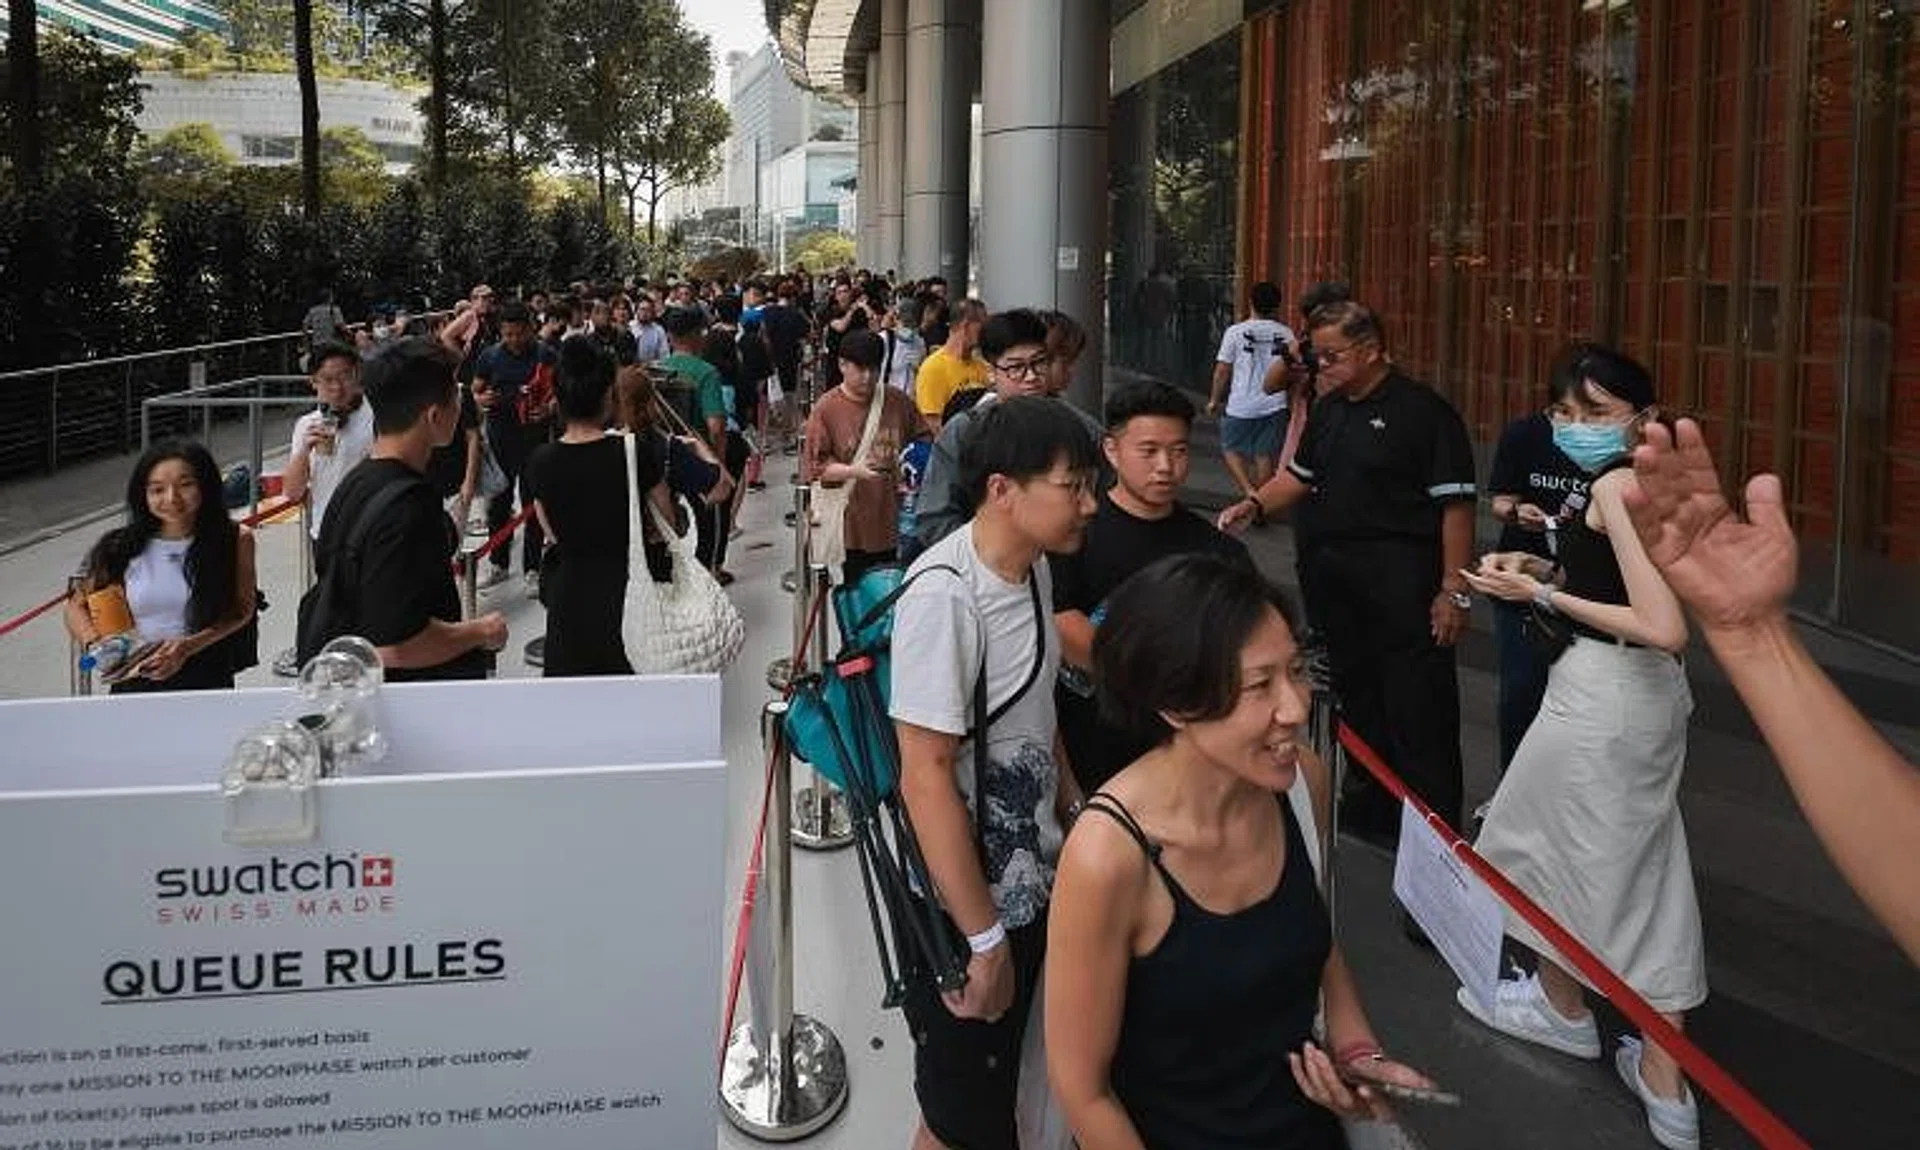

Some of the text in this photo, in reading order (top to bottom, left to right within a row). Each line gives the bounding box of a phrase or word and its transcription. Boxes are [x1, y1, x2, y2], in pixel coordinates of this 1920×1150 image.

[155, 853, 357, 899] swatch
[156, 895, 396, 925] SWISS MADE
[103, 938, 506, 998] QUEUE RULES
[218, 1033, 319, 1051] first-served
[324, 1031, 370, 1044] basis
[29, 1081, 64, 1094] one
[68, 1073, 152, 1091] MISSION
[158, 1070, 184, 1086] TO
[190, 1067, 226, 1083] THE
[231, 1059, 356, 1081] MOONPHASE
[360, 1055, 413, 1071] watch
[418, 1054, 447, 1070] per
[451, 1048, 532, 1066] customer
[31, 1108, 48, 1123] of
[201, 1097, 240, 1114] spot
[244, 1097, 258, 1110] is
[262, 1091, 331, 1109] allowed
[91, 1136, 114, 1150] be
[118, 1130, 183, 1149] eligible
[187, 1130, 205, 1145] to
[210, 1124, 294, 1145] purchase
[297, 1119, 327, 1135] the
[331, 1112, 412, 1132] MISSION
[418, 1110, 442, 1126] TO
[448, 1106, 483, 1124] THE
[487, 1096, 606, 1121] MOONPHASE
[610, 1094, 662, 1109] watch
